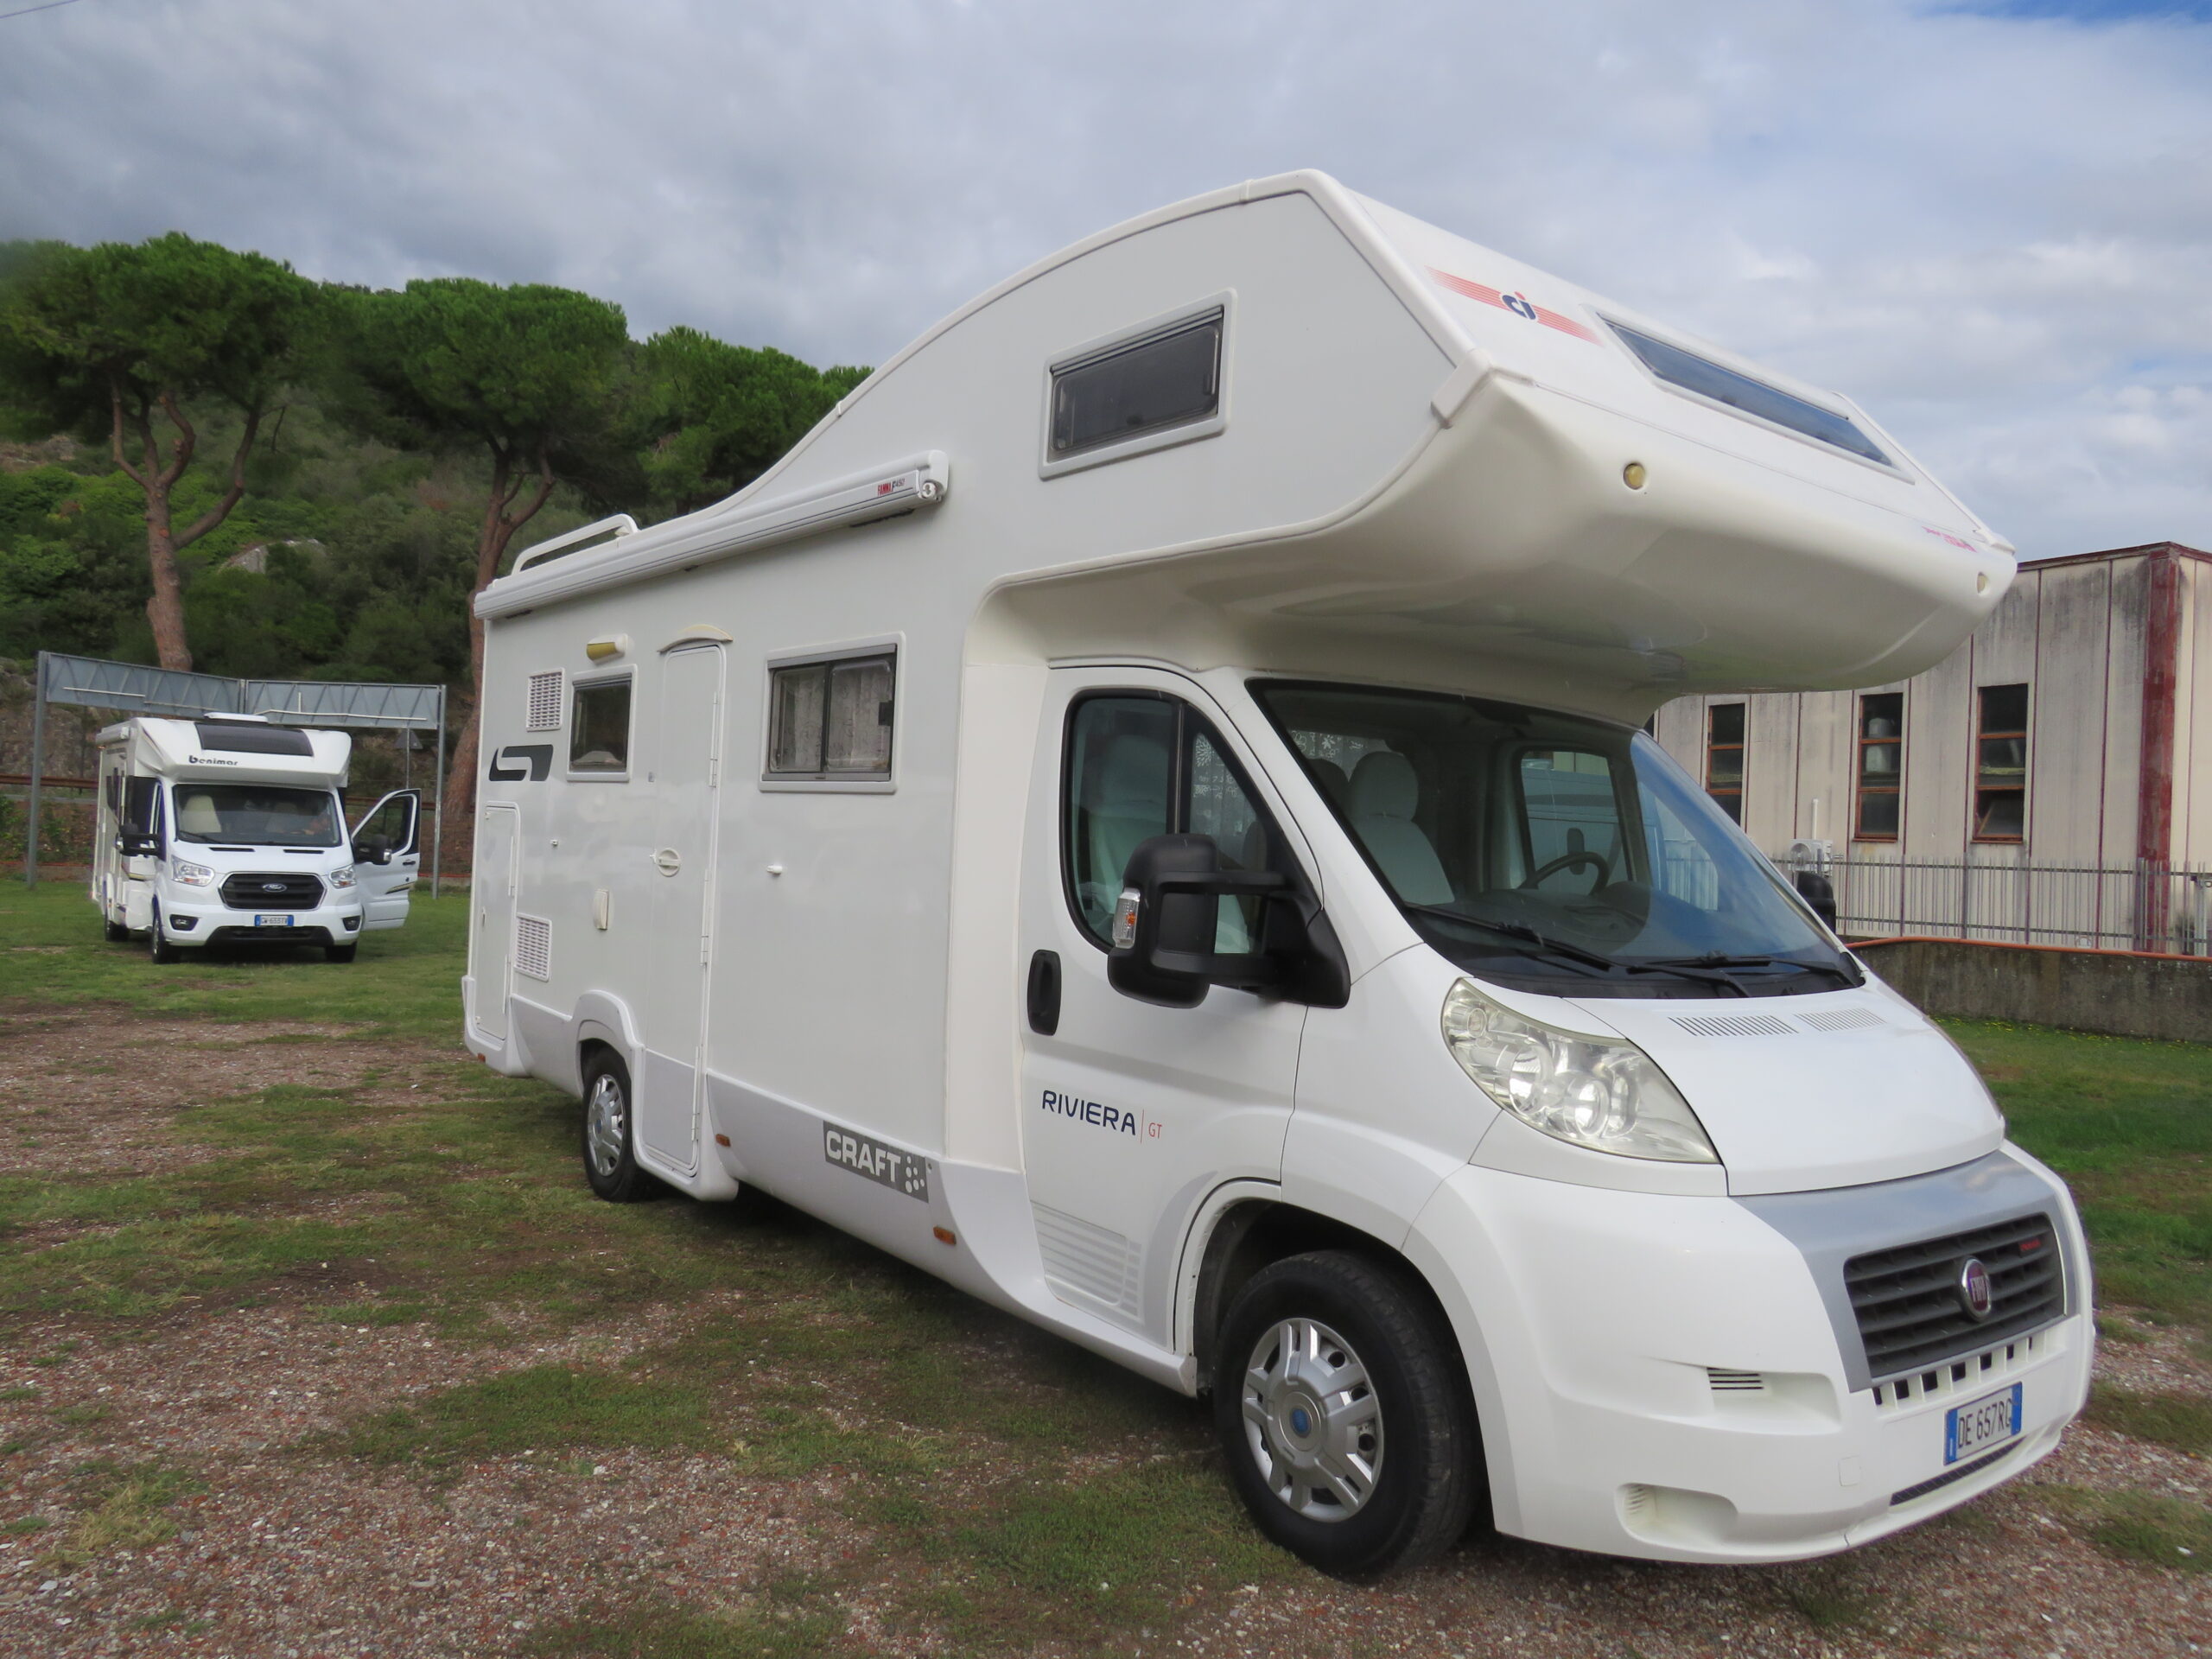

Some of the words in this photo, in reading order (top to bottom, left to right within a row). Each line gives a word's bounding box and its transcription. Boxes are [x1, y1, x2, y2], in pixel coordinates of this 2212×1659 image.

[188, 755, 238, 766] benimar
[1042, 1090, 1136, 1135] RIVIERA
[1148, 1122, 1163, 1140] GT
[826, 1129, 901, 1184] CRAFT
[1958, 1413, 1973, 1449] DE
